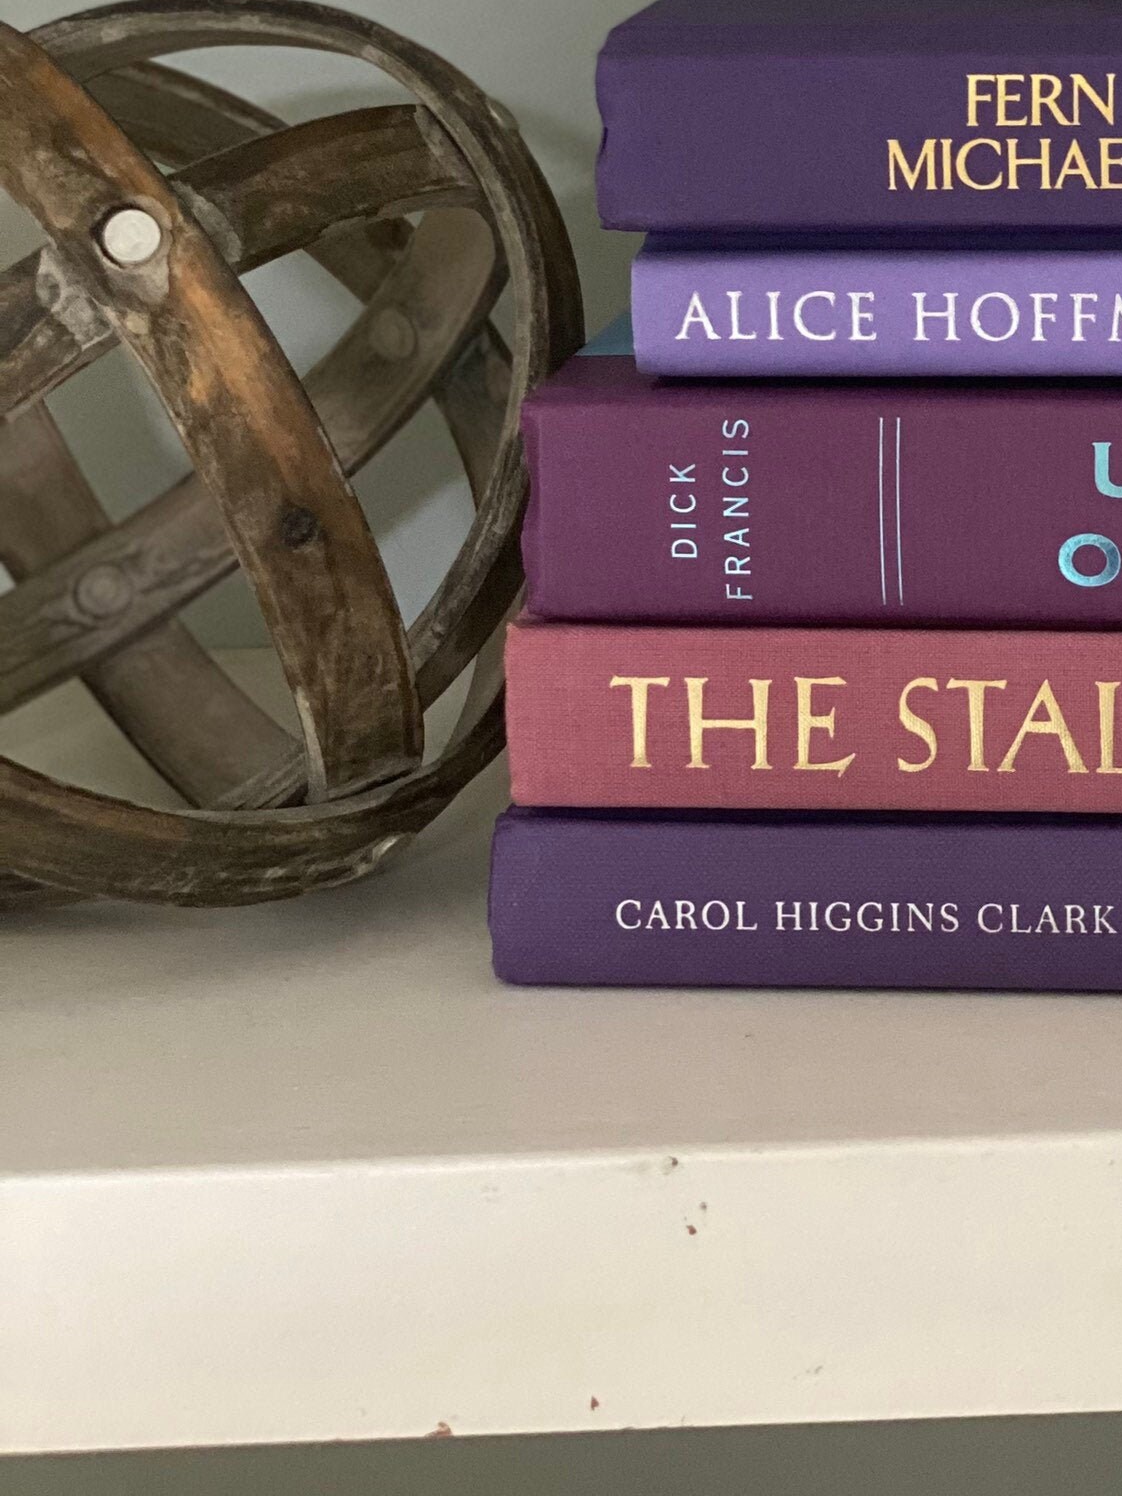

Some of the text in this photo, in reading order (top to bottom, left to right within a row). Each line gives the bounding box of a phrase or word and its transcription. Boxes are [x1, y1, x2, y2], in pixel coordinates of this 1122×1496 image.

[966, 72, 1116, 127] FERN
[674, 290, 877, 341] ALICE
[669, 463, 698, 559] DICK
[721, 419, 753, 600] FRANCIS
[609, 675, 856, 778] THE
[615, 899, 1118, 934] CAROL HIGGINS CLARK
